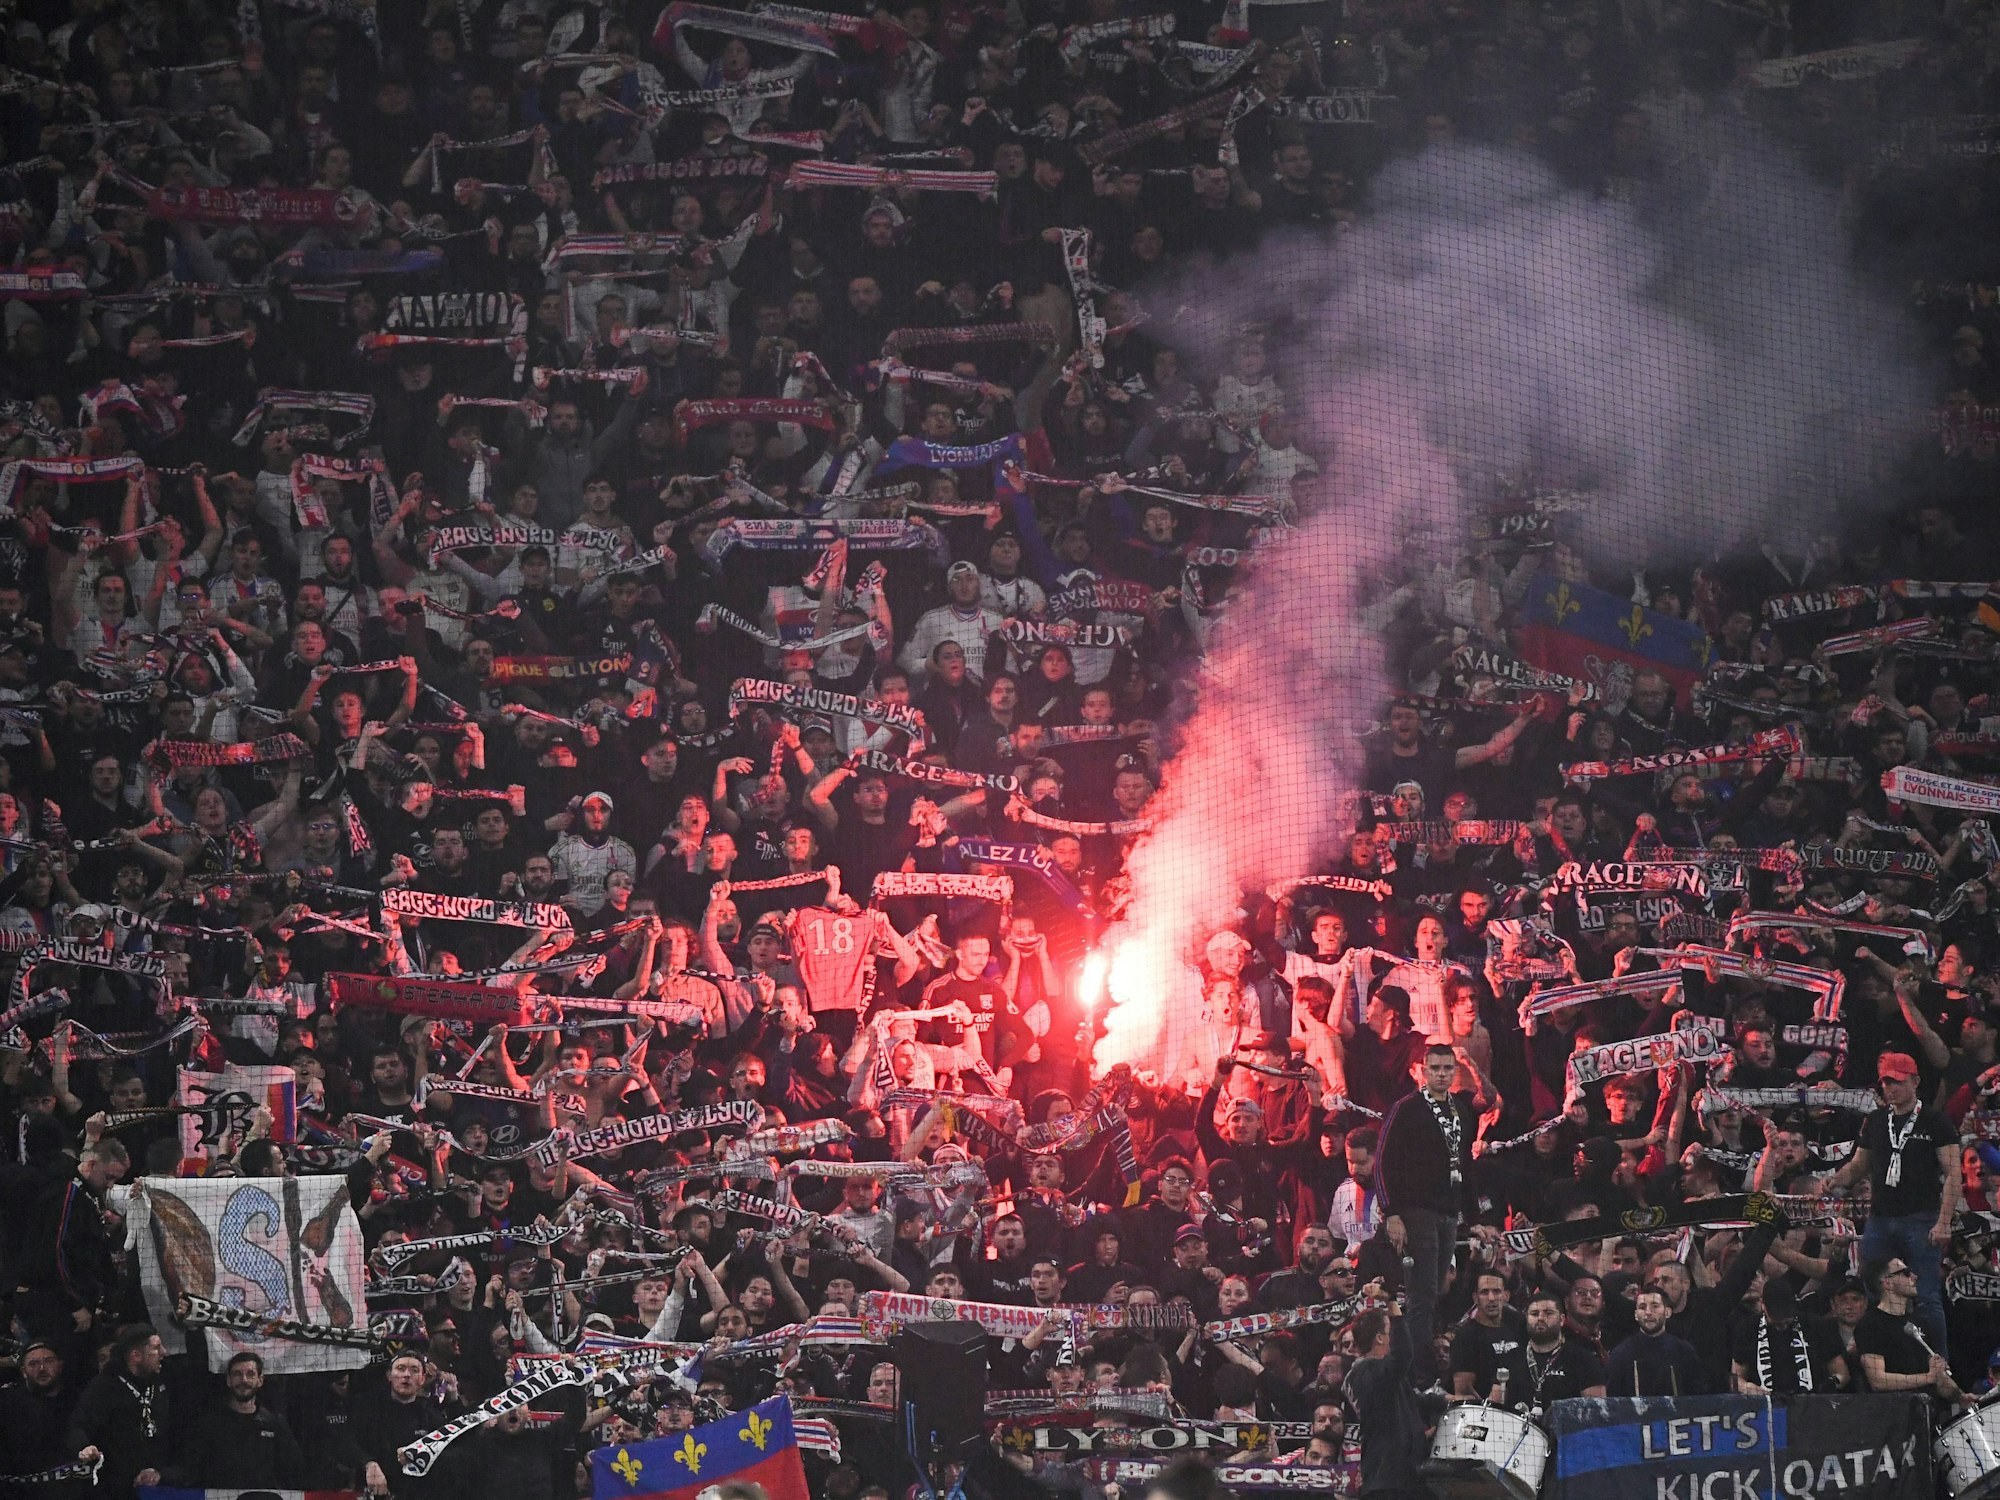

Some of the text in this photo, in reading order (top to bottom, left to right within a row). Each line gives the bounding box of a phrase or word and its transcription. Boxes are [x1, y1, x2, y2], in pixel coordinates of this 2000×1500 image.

[691, 400, 823, 419] Bad Gones
[930, 443, 1002, 464] LYONNAIS
[802, 686, 855, 716] NORD
[1903, 783, 1992, 805] LYONNAIS EST
[1905, 773, 1939, 787] ROUGE
[1941, 781, 1952, 789] ET
[1954, 783, 1980, 793] BLEU
[959, 843, 1054, 878] ALLEZ L'OL
[1564, 862, 1642, 887] RAGE
[871, 884, 1002, 900] OLYMPIQUE LYONNAIS
[443, 896, 494, 922] NORD
[807, 917, 855, 956] 18
[1576, 1041, 1653, 1082] RAGE
[621, 1113, 673, 1145] NORD
[806, 1163, 880, 1178] OLYMPIQU
[887, 1297, 929, 1317] ANTI
[1209, 1313, 1270, 1343] BAD
[488, 1360, 595, 1415] GONES
[1032, 1425, 1241, 1452] LYON
[1641, 1411, 1758, 1460] LET'S
[1219, 1465, 1334, 1489] GONES
[1656, 1469, 1761, 1500] KICK
